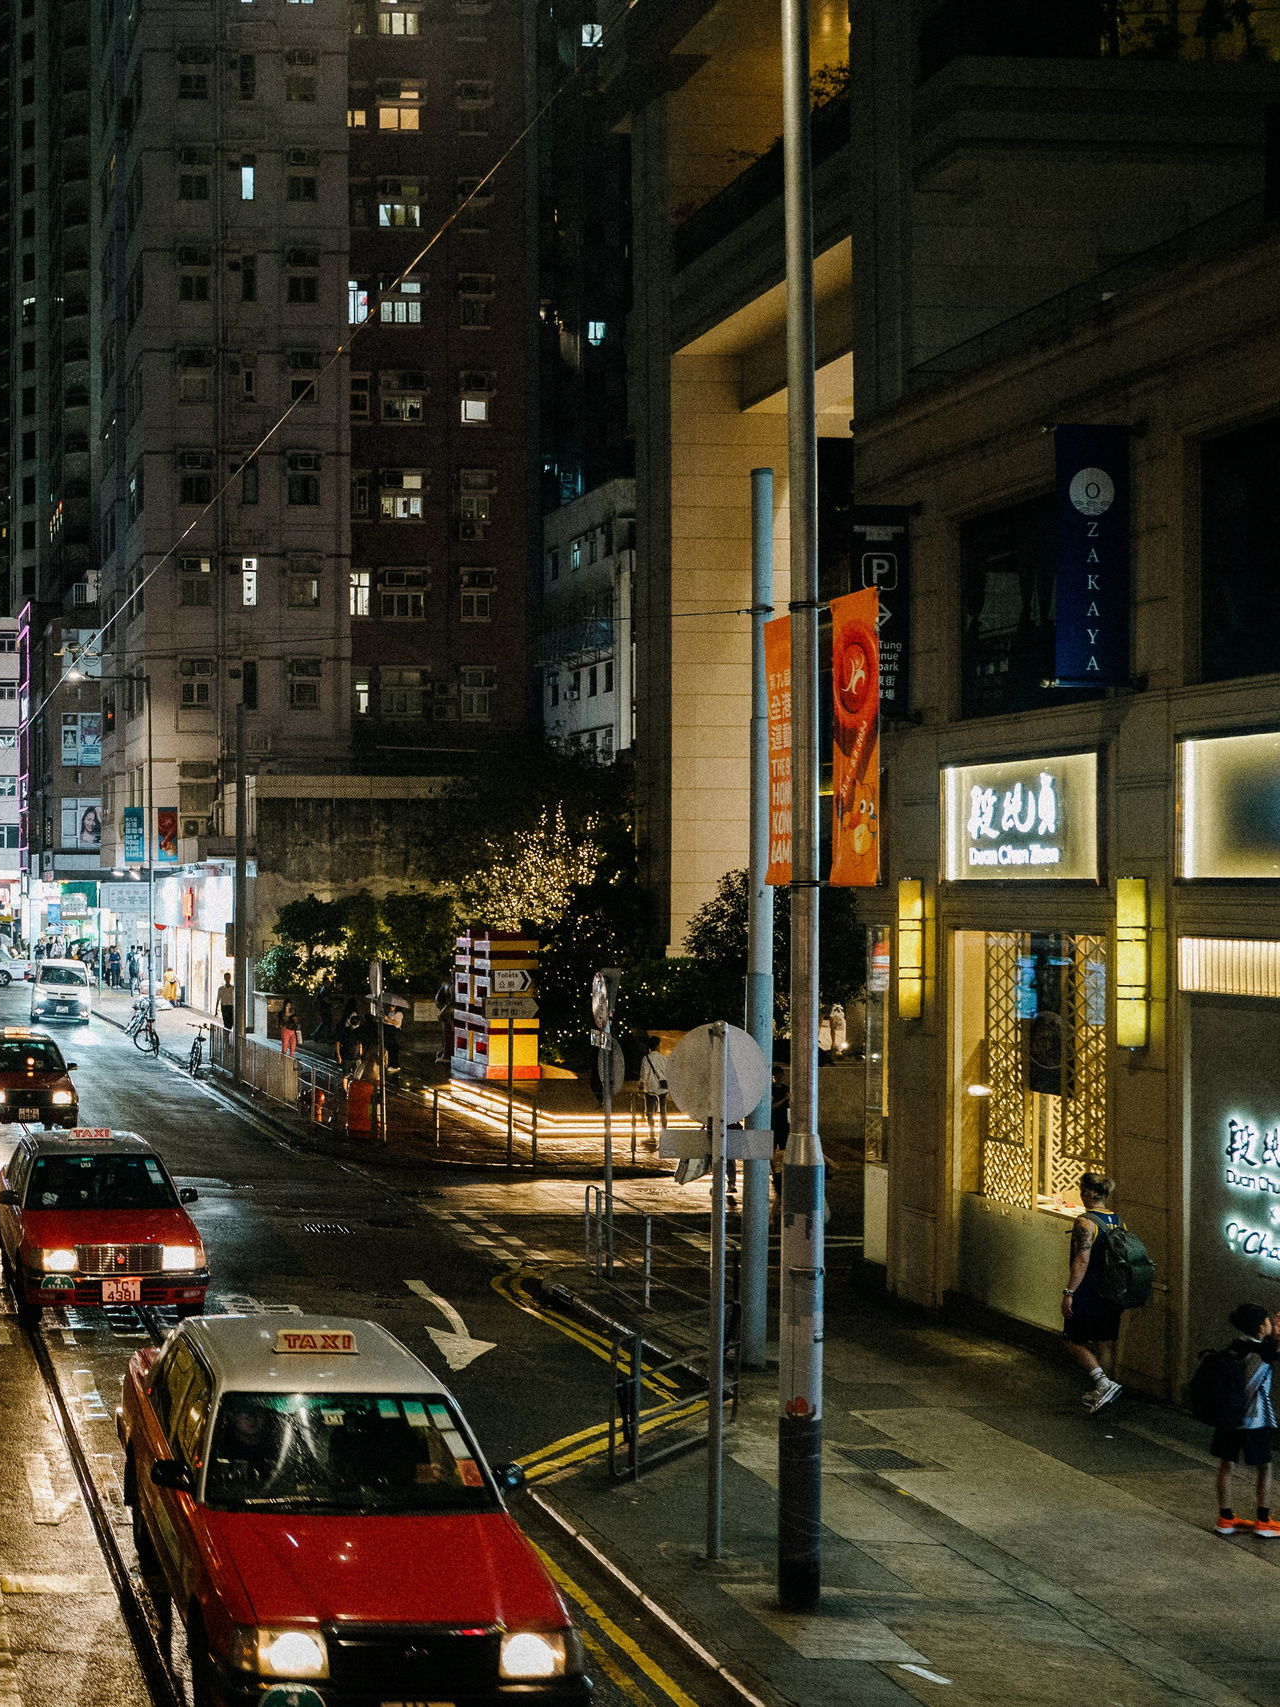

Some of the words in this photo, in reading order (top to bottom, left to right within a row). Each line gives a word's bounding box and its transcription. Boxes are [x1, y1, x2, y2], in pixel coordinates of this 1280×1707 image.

[771, 722, 792, 751] 運動
[772, 781, 792, 806] HON
[772, 810, 792, 834] KON
[72, 1129, 110, 1138] TAXI
[1226, 1169, 1256, 1189] Duan
[1258, 1176, 1280, 1195] Chu
[107, 1290, 136, 1302] 4381
[114, 1281, 130, 1293] TC
[283, 1334, 352, 1350] TAXI
